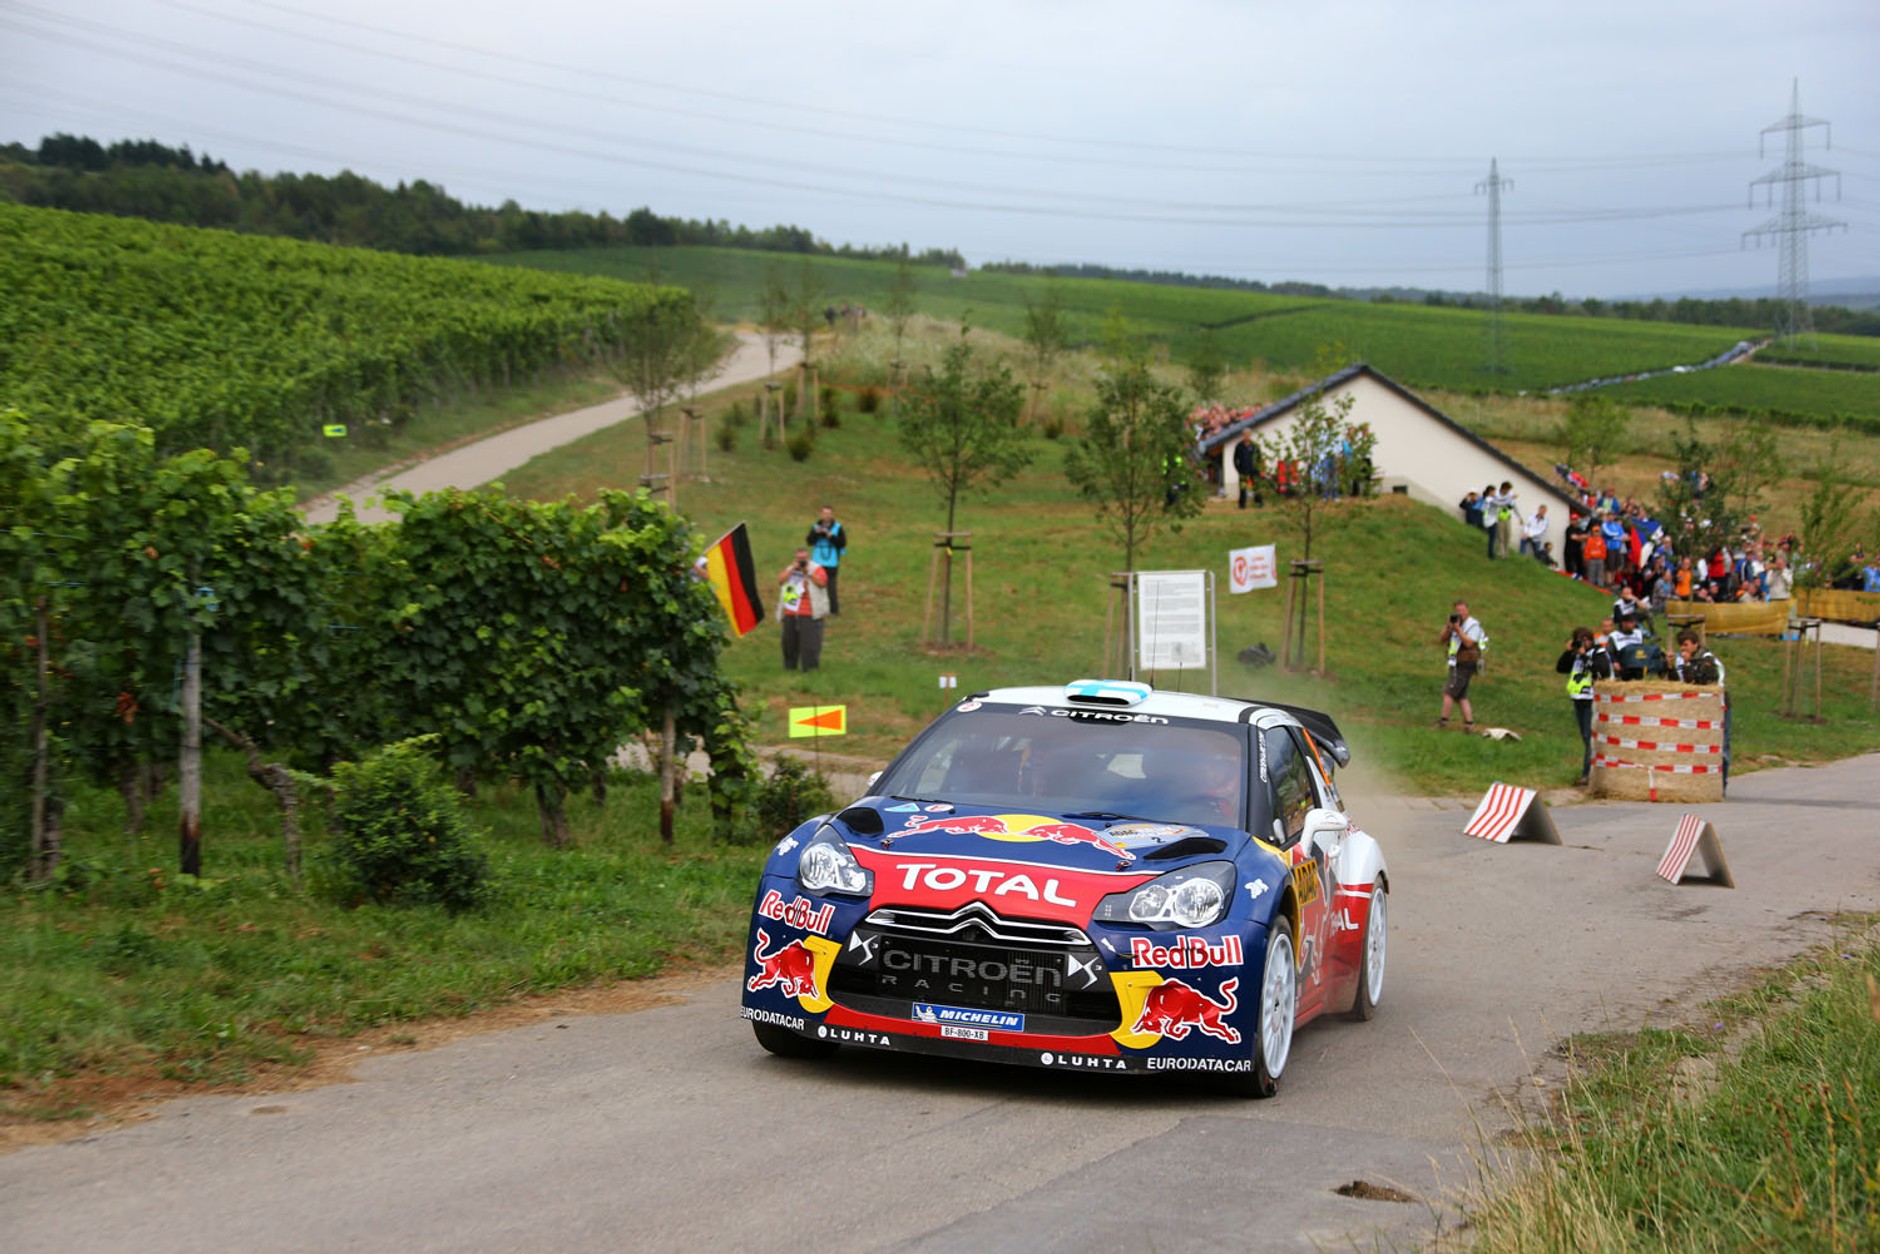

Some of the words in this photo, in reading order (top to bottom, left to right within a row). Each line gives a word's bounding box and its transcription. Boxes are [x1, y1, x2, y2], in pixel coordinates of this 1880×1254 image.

[896, 863, 1077, 908] TOTAL
[940, 1010, 1018, 1026] MICHELIN
[830, 1029, 891, 1047] LUHTA
[1058, 1054, 1127, 1069] LUHTA
[1147, 1056, 1252, 1073] EURODATACAR
